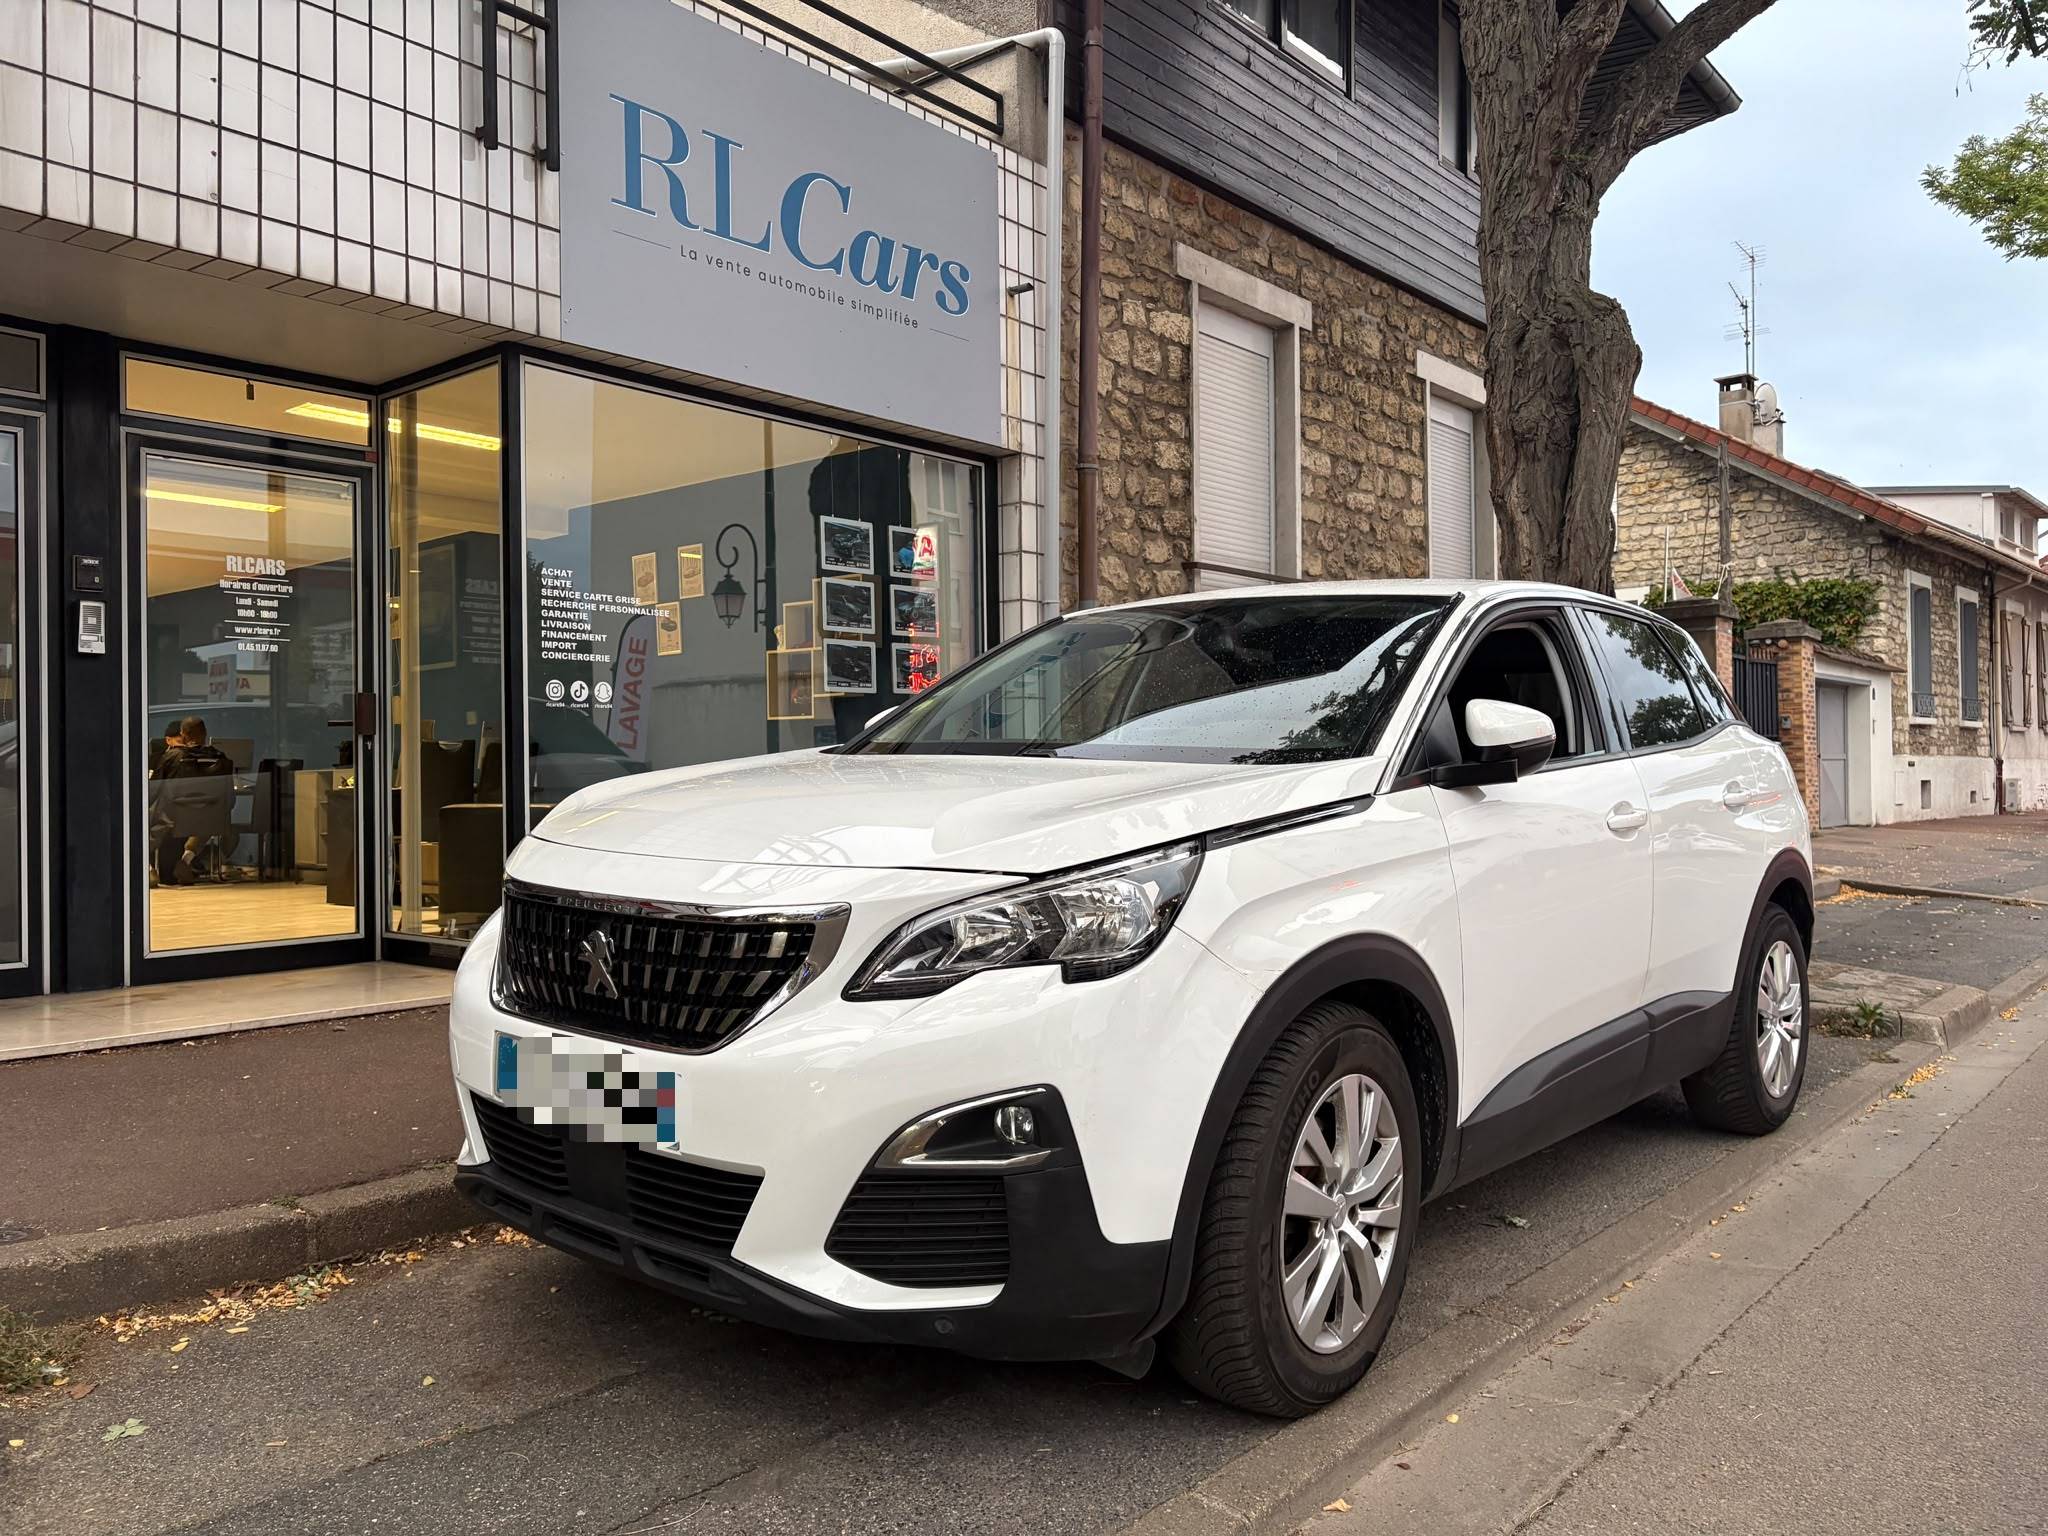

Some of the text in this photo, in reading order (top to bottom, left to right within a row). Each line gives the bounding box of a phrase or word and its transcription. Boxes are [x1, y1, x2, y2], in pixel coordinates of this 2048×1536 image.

[609, 92, 970, 317] RLCars
[680, 244, 919, 329] La vente automobile simplifiée
[226, 555, 285, 576] RLCARS
[541, 568, 574, 578] ACHAT
[220, 579, 293, 594] Horaires d'ouverture
[541, 578, 573, 588] VENTE
[236, 596, 252, 606] Lundi
[257, 599, 279, 607] Samedi
[541, 588, 641, 605] SERVICE CARTE GRISE
[541, 599, 597, 611] RECHERCHE
[541, 609, 589, 621] GARANTIE
[235, 625, 281, 636] www.rlcars.fr
[541, 619, 592, 631] LIVRAISON
[541, 630, 608, 642] FINANCEMENT
[541, 640, 578, 651] IMPORT
[541, 651, 611, 663] CONCIERGERIE
[617, 635, 648, 750] LAVAGE
